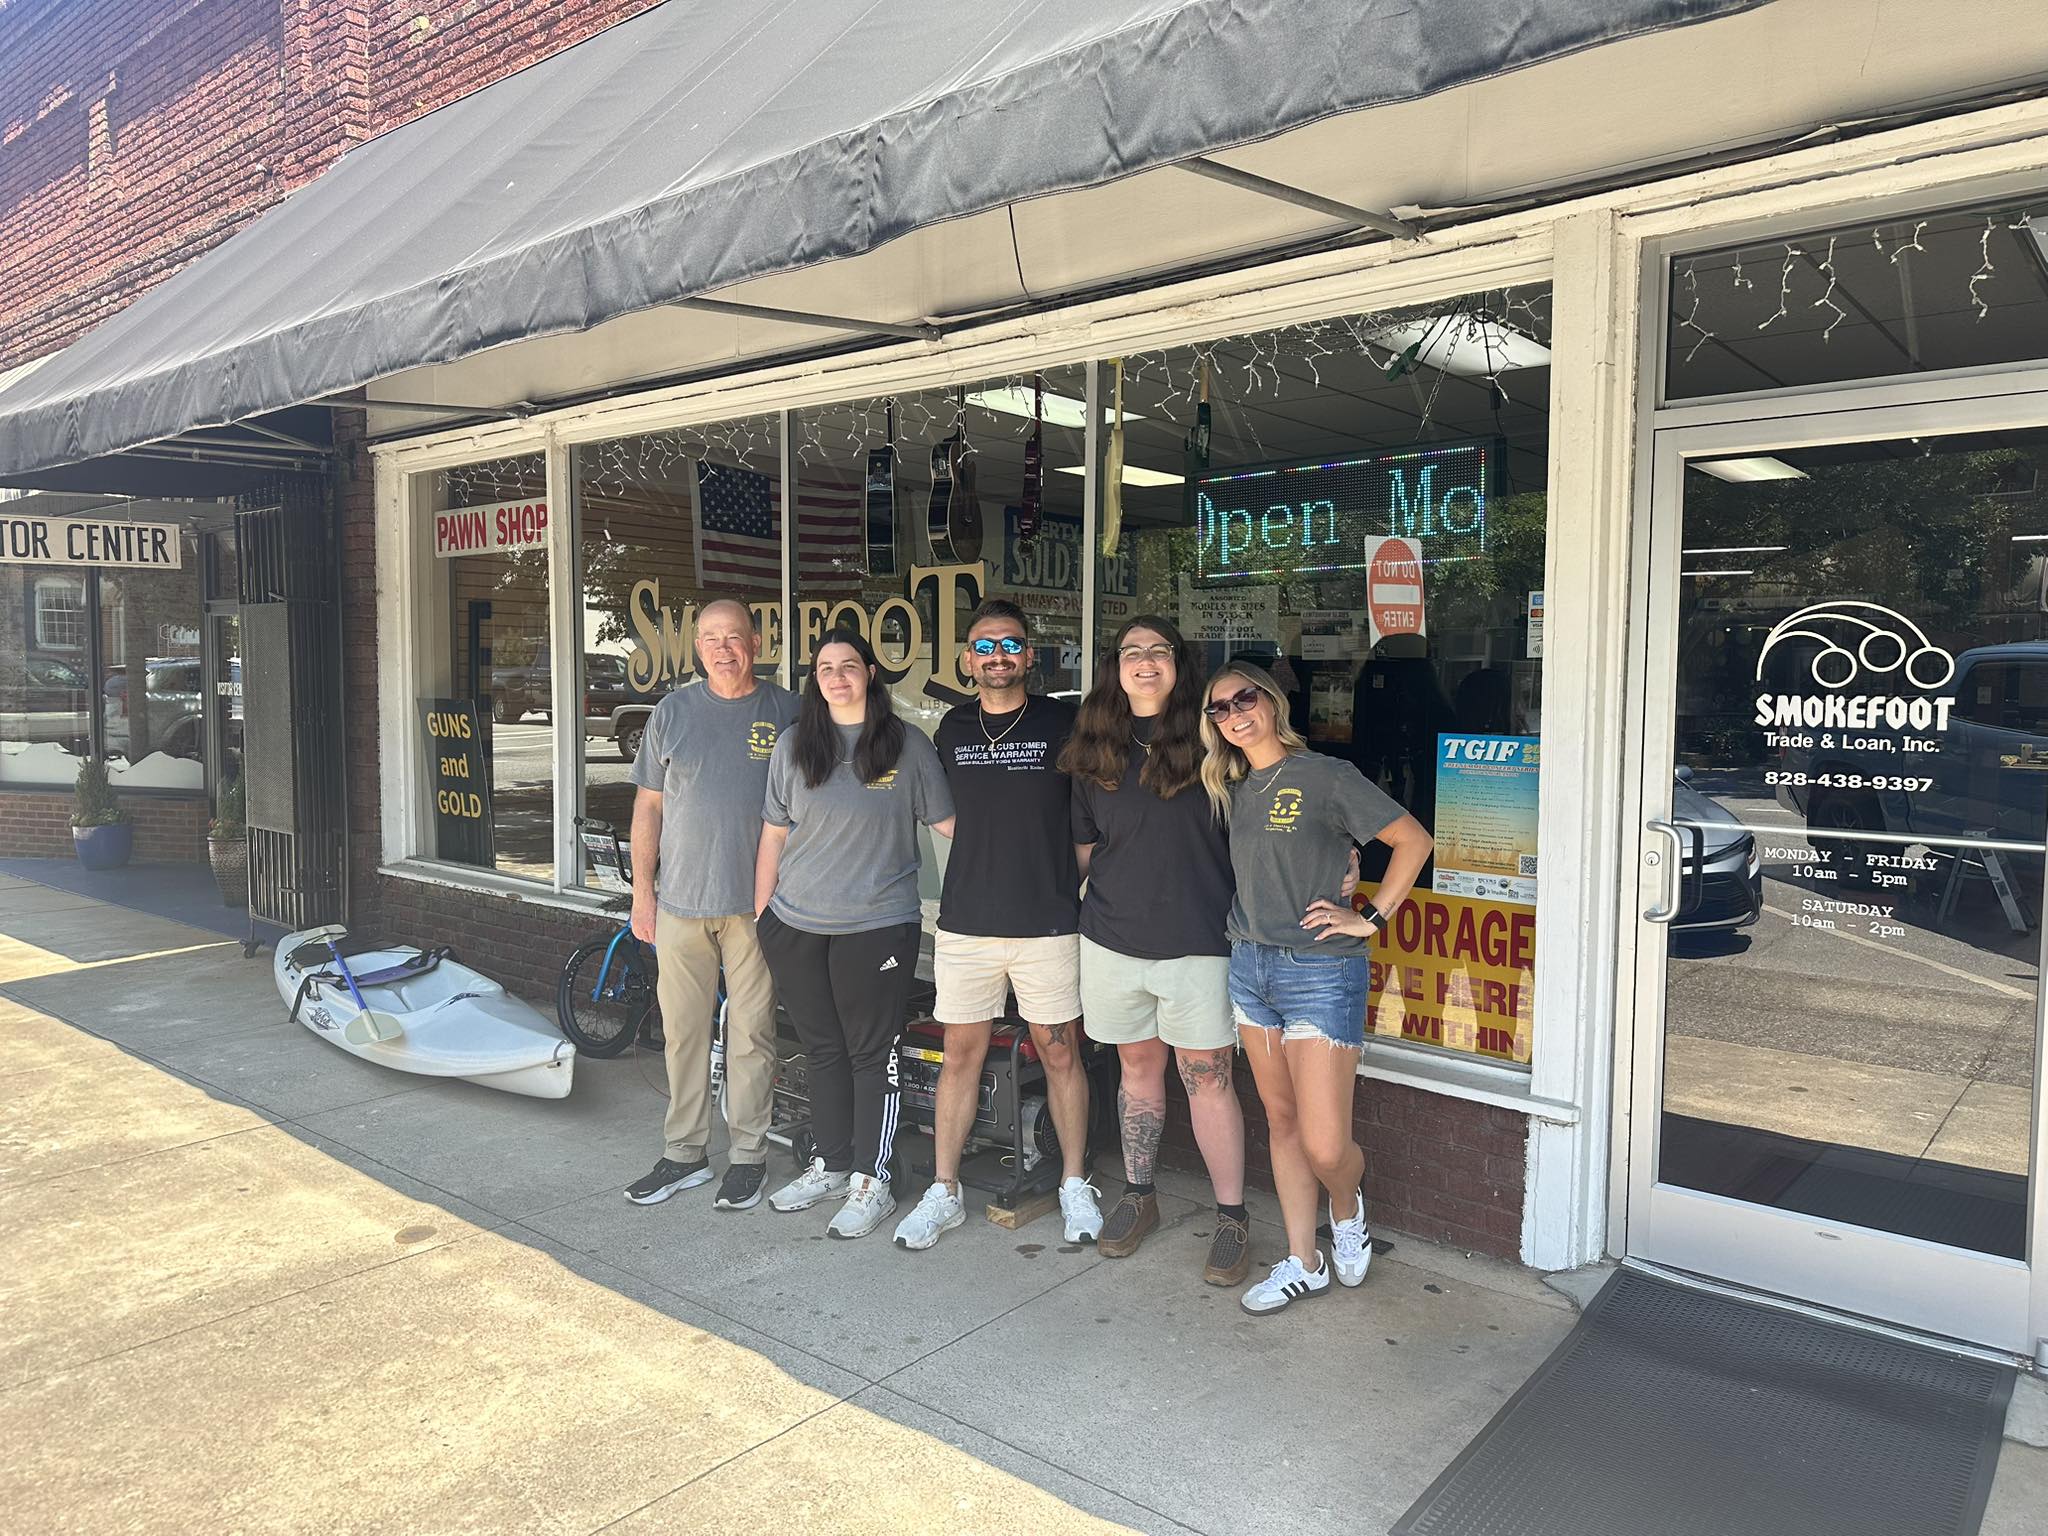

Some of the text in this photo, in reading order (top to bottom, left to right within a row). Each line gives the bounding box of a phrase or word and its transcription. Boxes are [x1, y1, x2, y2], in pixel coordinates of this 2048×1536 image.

[436, 503, 548, 552] PAWN SHOP
[67, 523, 170, 563] CENTER
[1011, 537, 1071, 588] SOLD
[1011, 592, 1060, 611] ALWAYS
[1191, 602, 1227, 612] MODELS
[627, 559, 985, 695] SMEFOOT
[1202, 611, 1254, 620] IN STOCK
[1754, 692, 1956, 732] SMOKEFOOT
[426, 711, 471, 739] GUNS
[953, 744, 987, 755] QUALITY
[996, 741, 1048, 752] CUSTOMER
[1444, 738, 1520, 763] TGIF
[1763, 731, 1941, 754] Trade & Loan, Inc.
[440, 752, 470, 779] and
[955, 749, 1046, 762] SERVICE WARRANTY
[1764, 770, 1934, 793] 828-438-9397
[438, 789, 482, 818] GOLD
[1764, 846, 1833, 863] MONDAY
[1866, 853, 1940, 871] FRIDAY
[1792, 863, 1838, 880] 10am
[1871, 870, 1908, 887] 5pm
[1801, 898, 1894, 918] SATURDAY
[1791, 912, 1836, 929] 10am
[1869, 920, 1906, 938] 2pm
[1401, 1011, 1524, 1058] WITHIN
